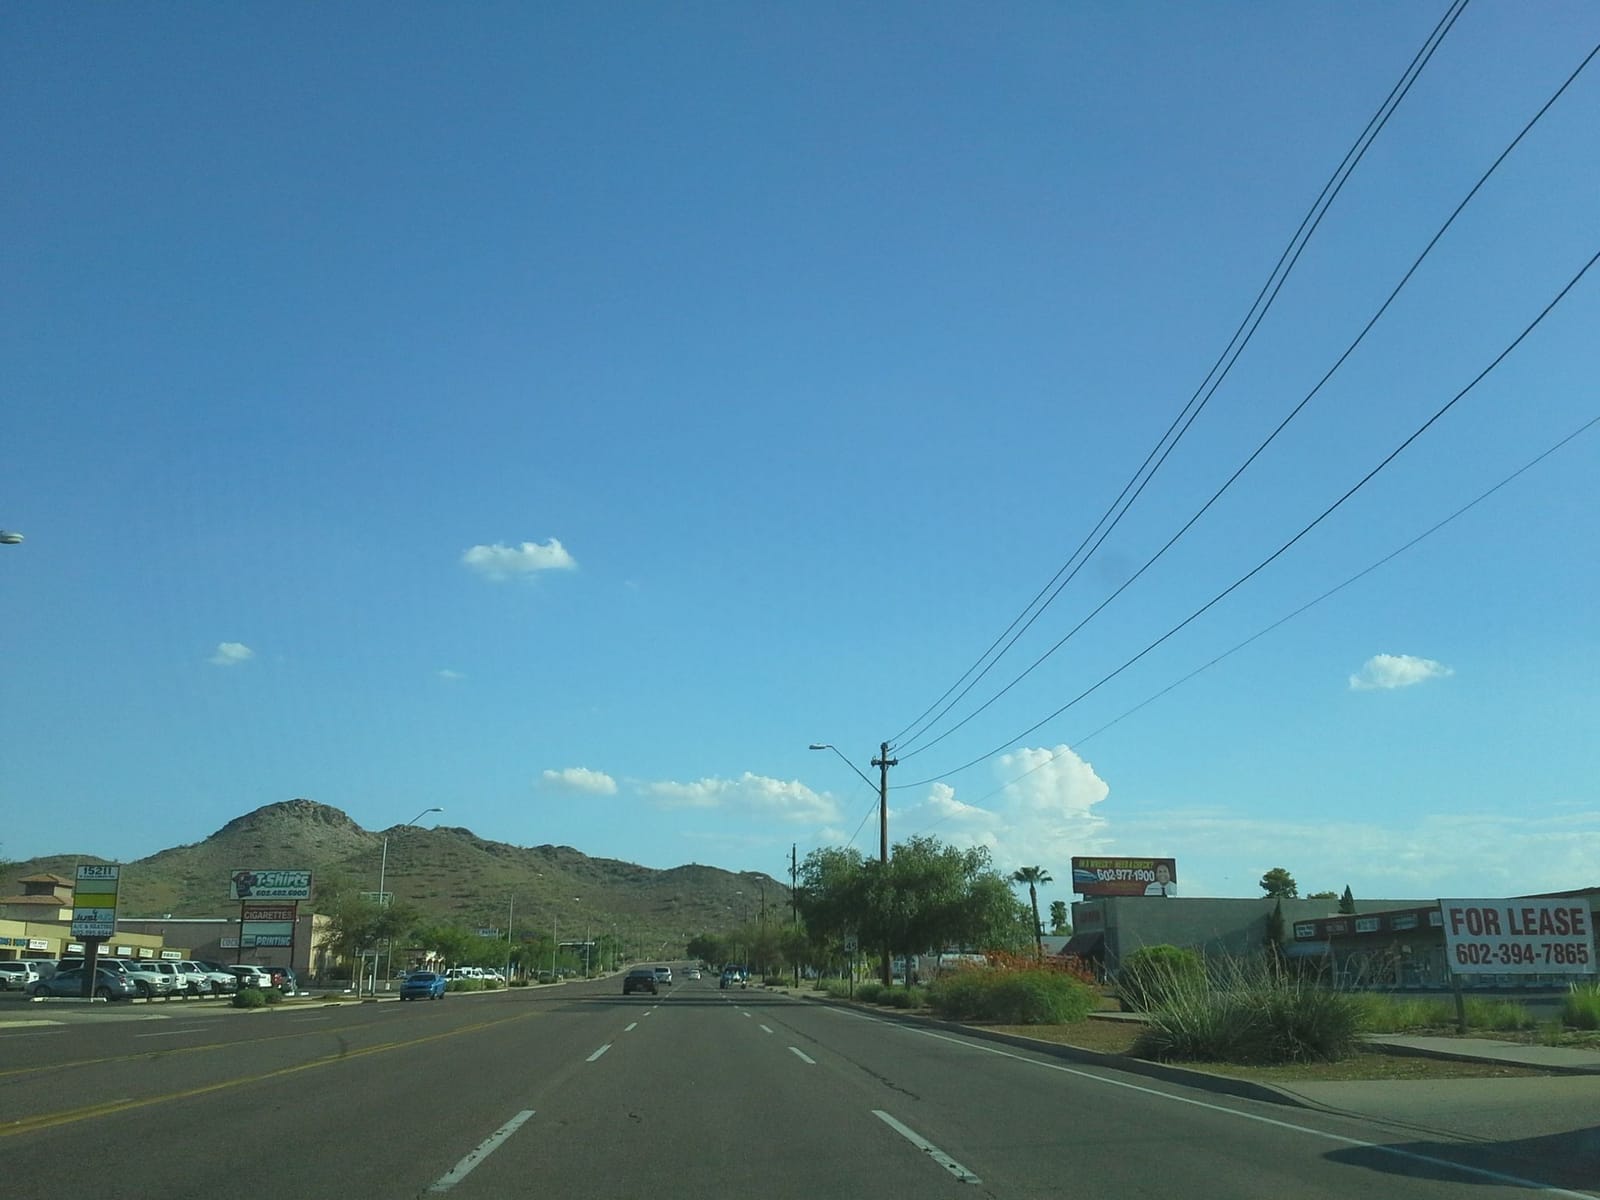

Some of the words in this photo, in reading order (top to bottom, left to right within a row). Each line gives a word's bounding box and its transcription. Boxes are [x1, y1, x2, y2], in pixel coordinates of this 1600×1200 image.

[84, 867, 112, 875] 15211
[1097, 869, 1155, 881] 602-977-1900
[256, 872, 310, 888] T-Shirts
[244, 911, 293, 920] CIGARETTES
[1449, 908, 1502, 936] FOR
[1508, 908, 1587, 936] LEASE
[255, 936, 291, 946] PRINTING
[1456, 944, 1590, 964] 602-394-7865
